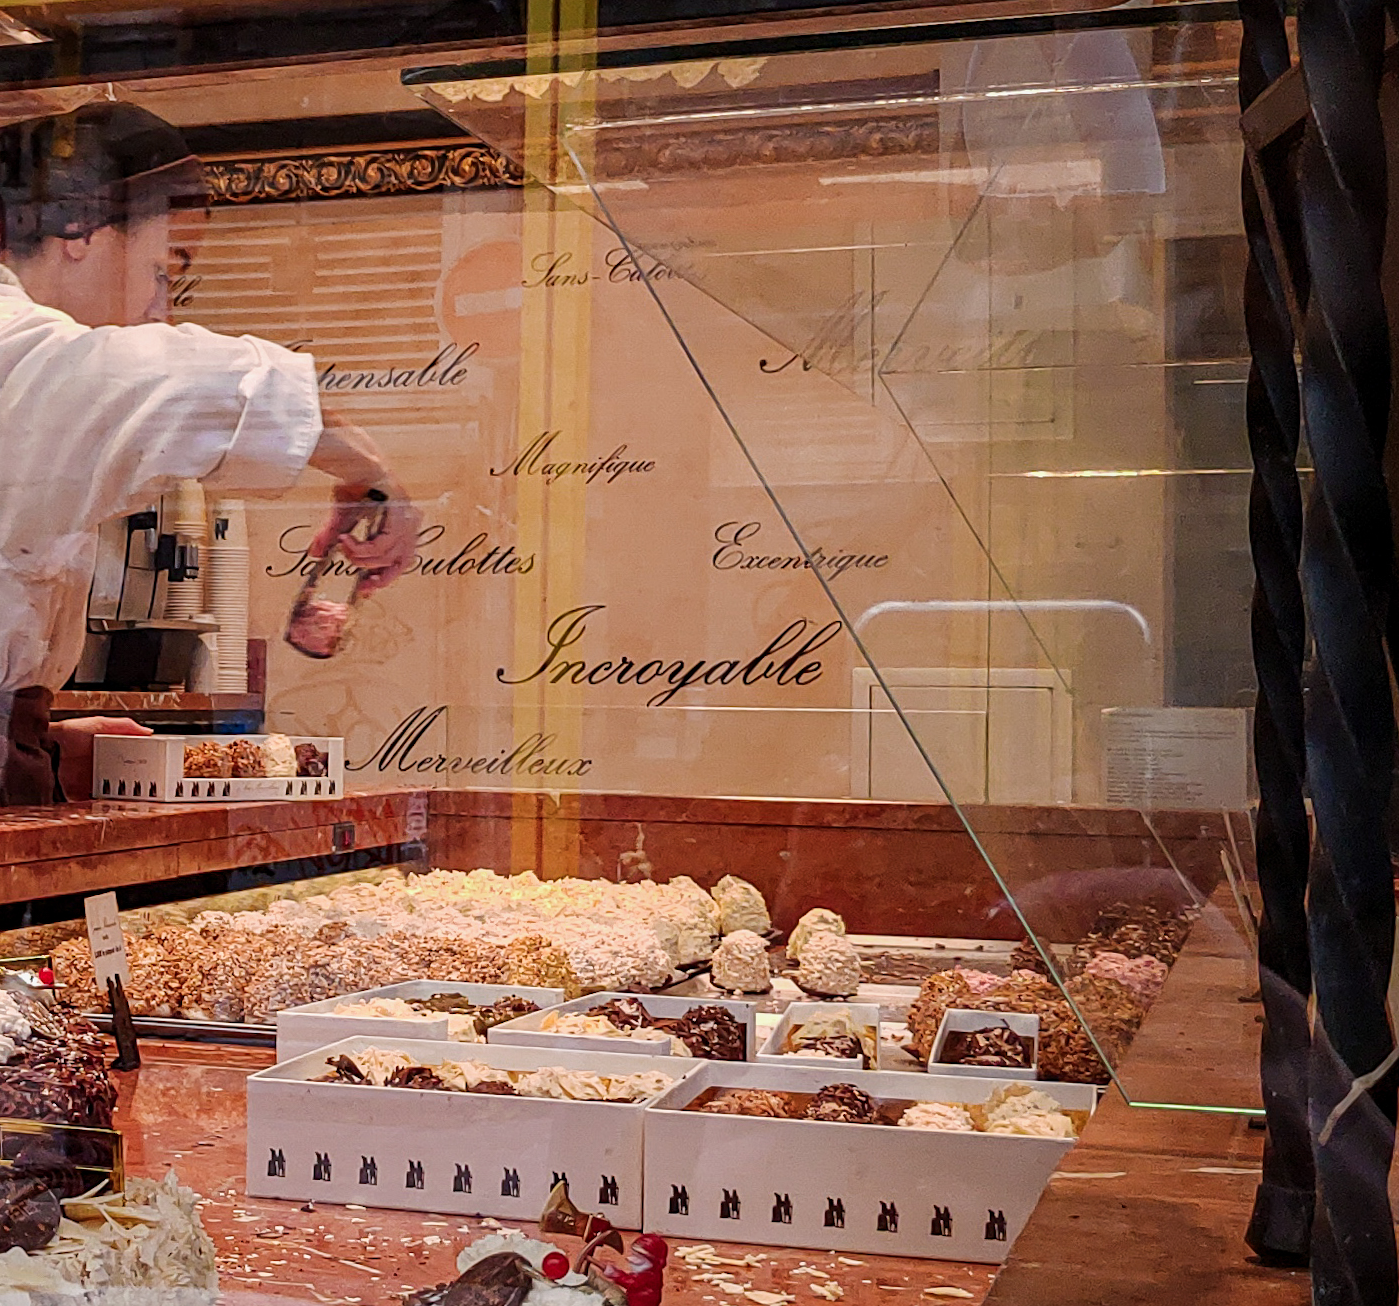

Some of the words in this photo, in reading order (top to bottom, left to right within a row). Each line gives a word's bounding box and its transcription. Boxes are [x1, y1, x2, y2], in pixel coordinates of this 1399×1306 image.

[489, 430, 657, 485] Magnifique
[712, 521, 890, 582] Excentrique
[496, 605, 843, 708] Incroyable
[344, 704, 593, 777] Merveilleux
